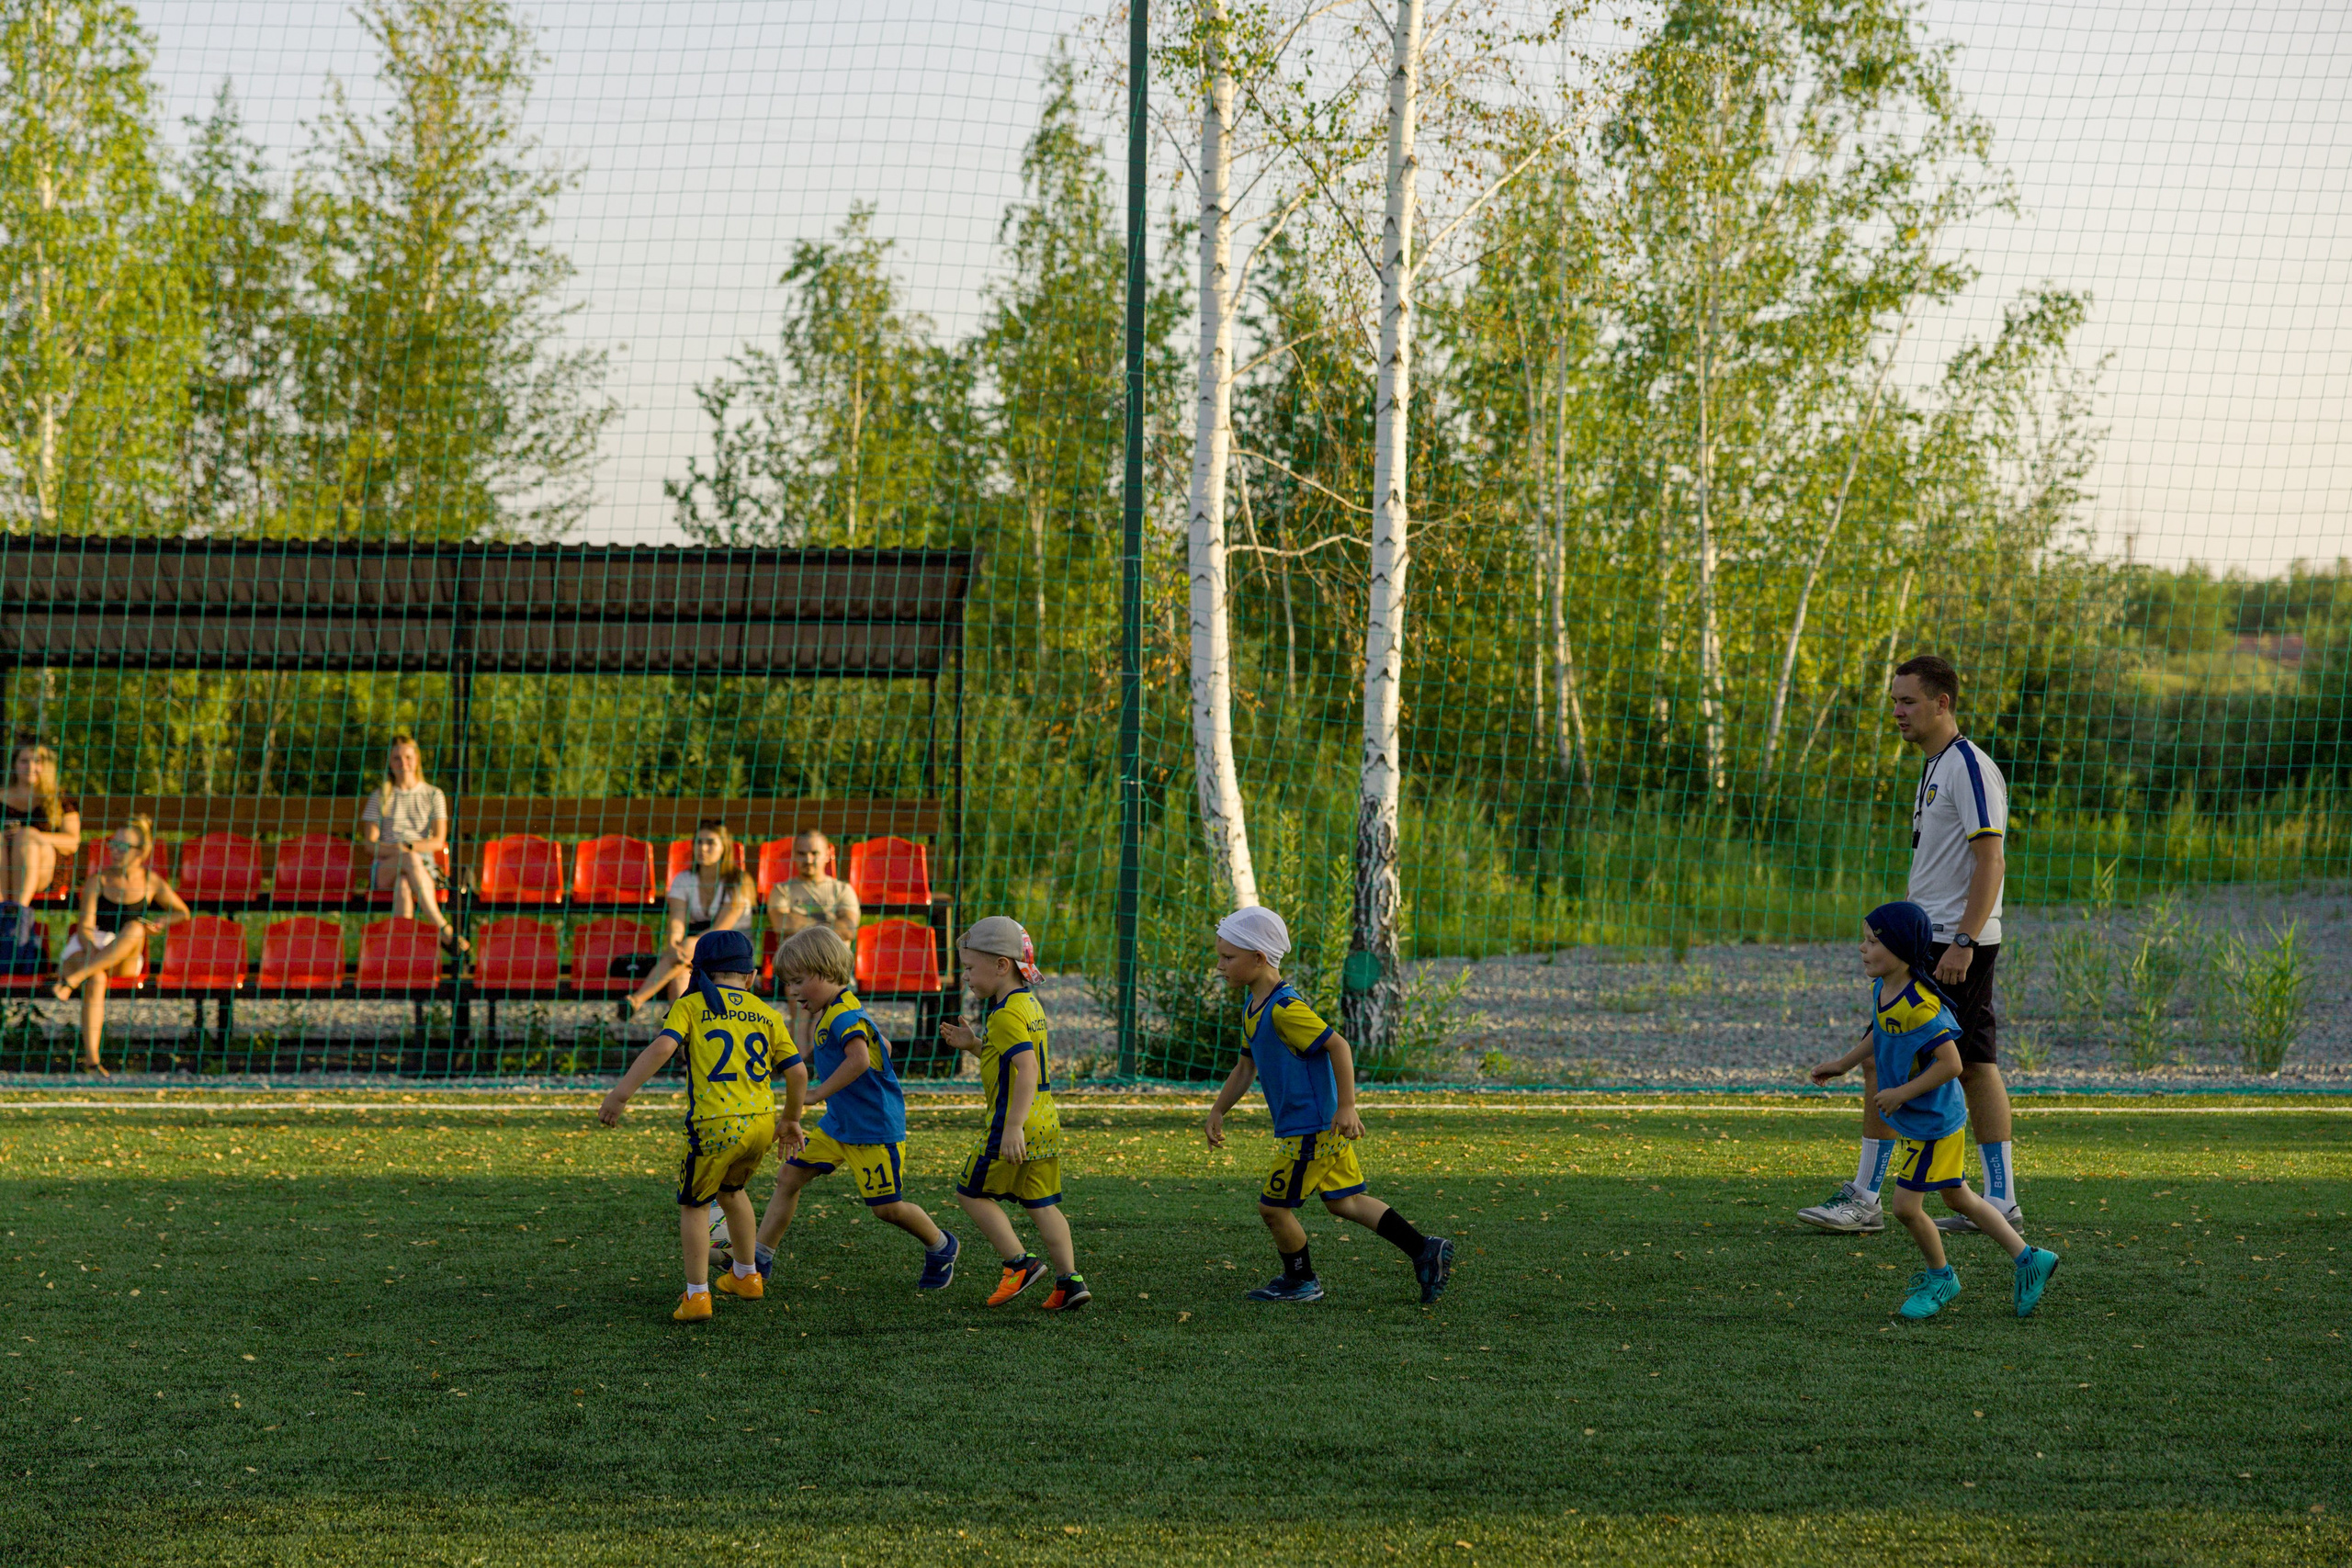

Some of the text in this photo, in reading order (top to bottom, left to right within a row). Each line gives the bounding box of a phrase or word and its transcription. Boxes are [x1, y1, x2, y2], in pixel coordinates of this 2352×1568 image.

[704, 1029, 770, 1083] 28
[1037, 1039, 1050, 1092] 1
[1875, 1149, 1891, 1183] Bench.
[1902, 1146, 1919, 1171] 7
[1990, 1154, 2003, 1189] Bench.
[862, 1162, 892, 1190] 21
[1270, 1169, 1285, 1192] 6
